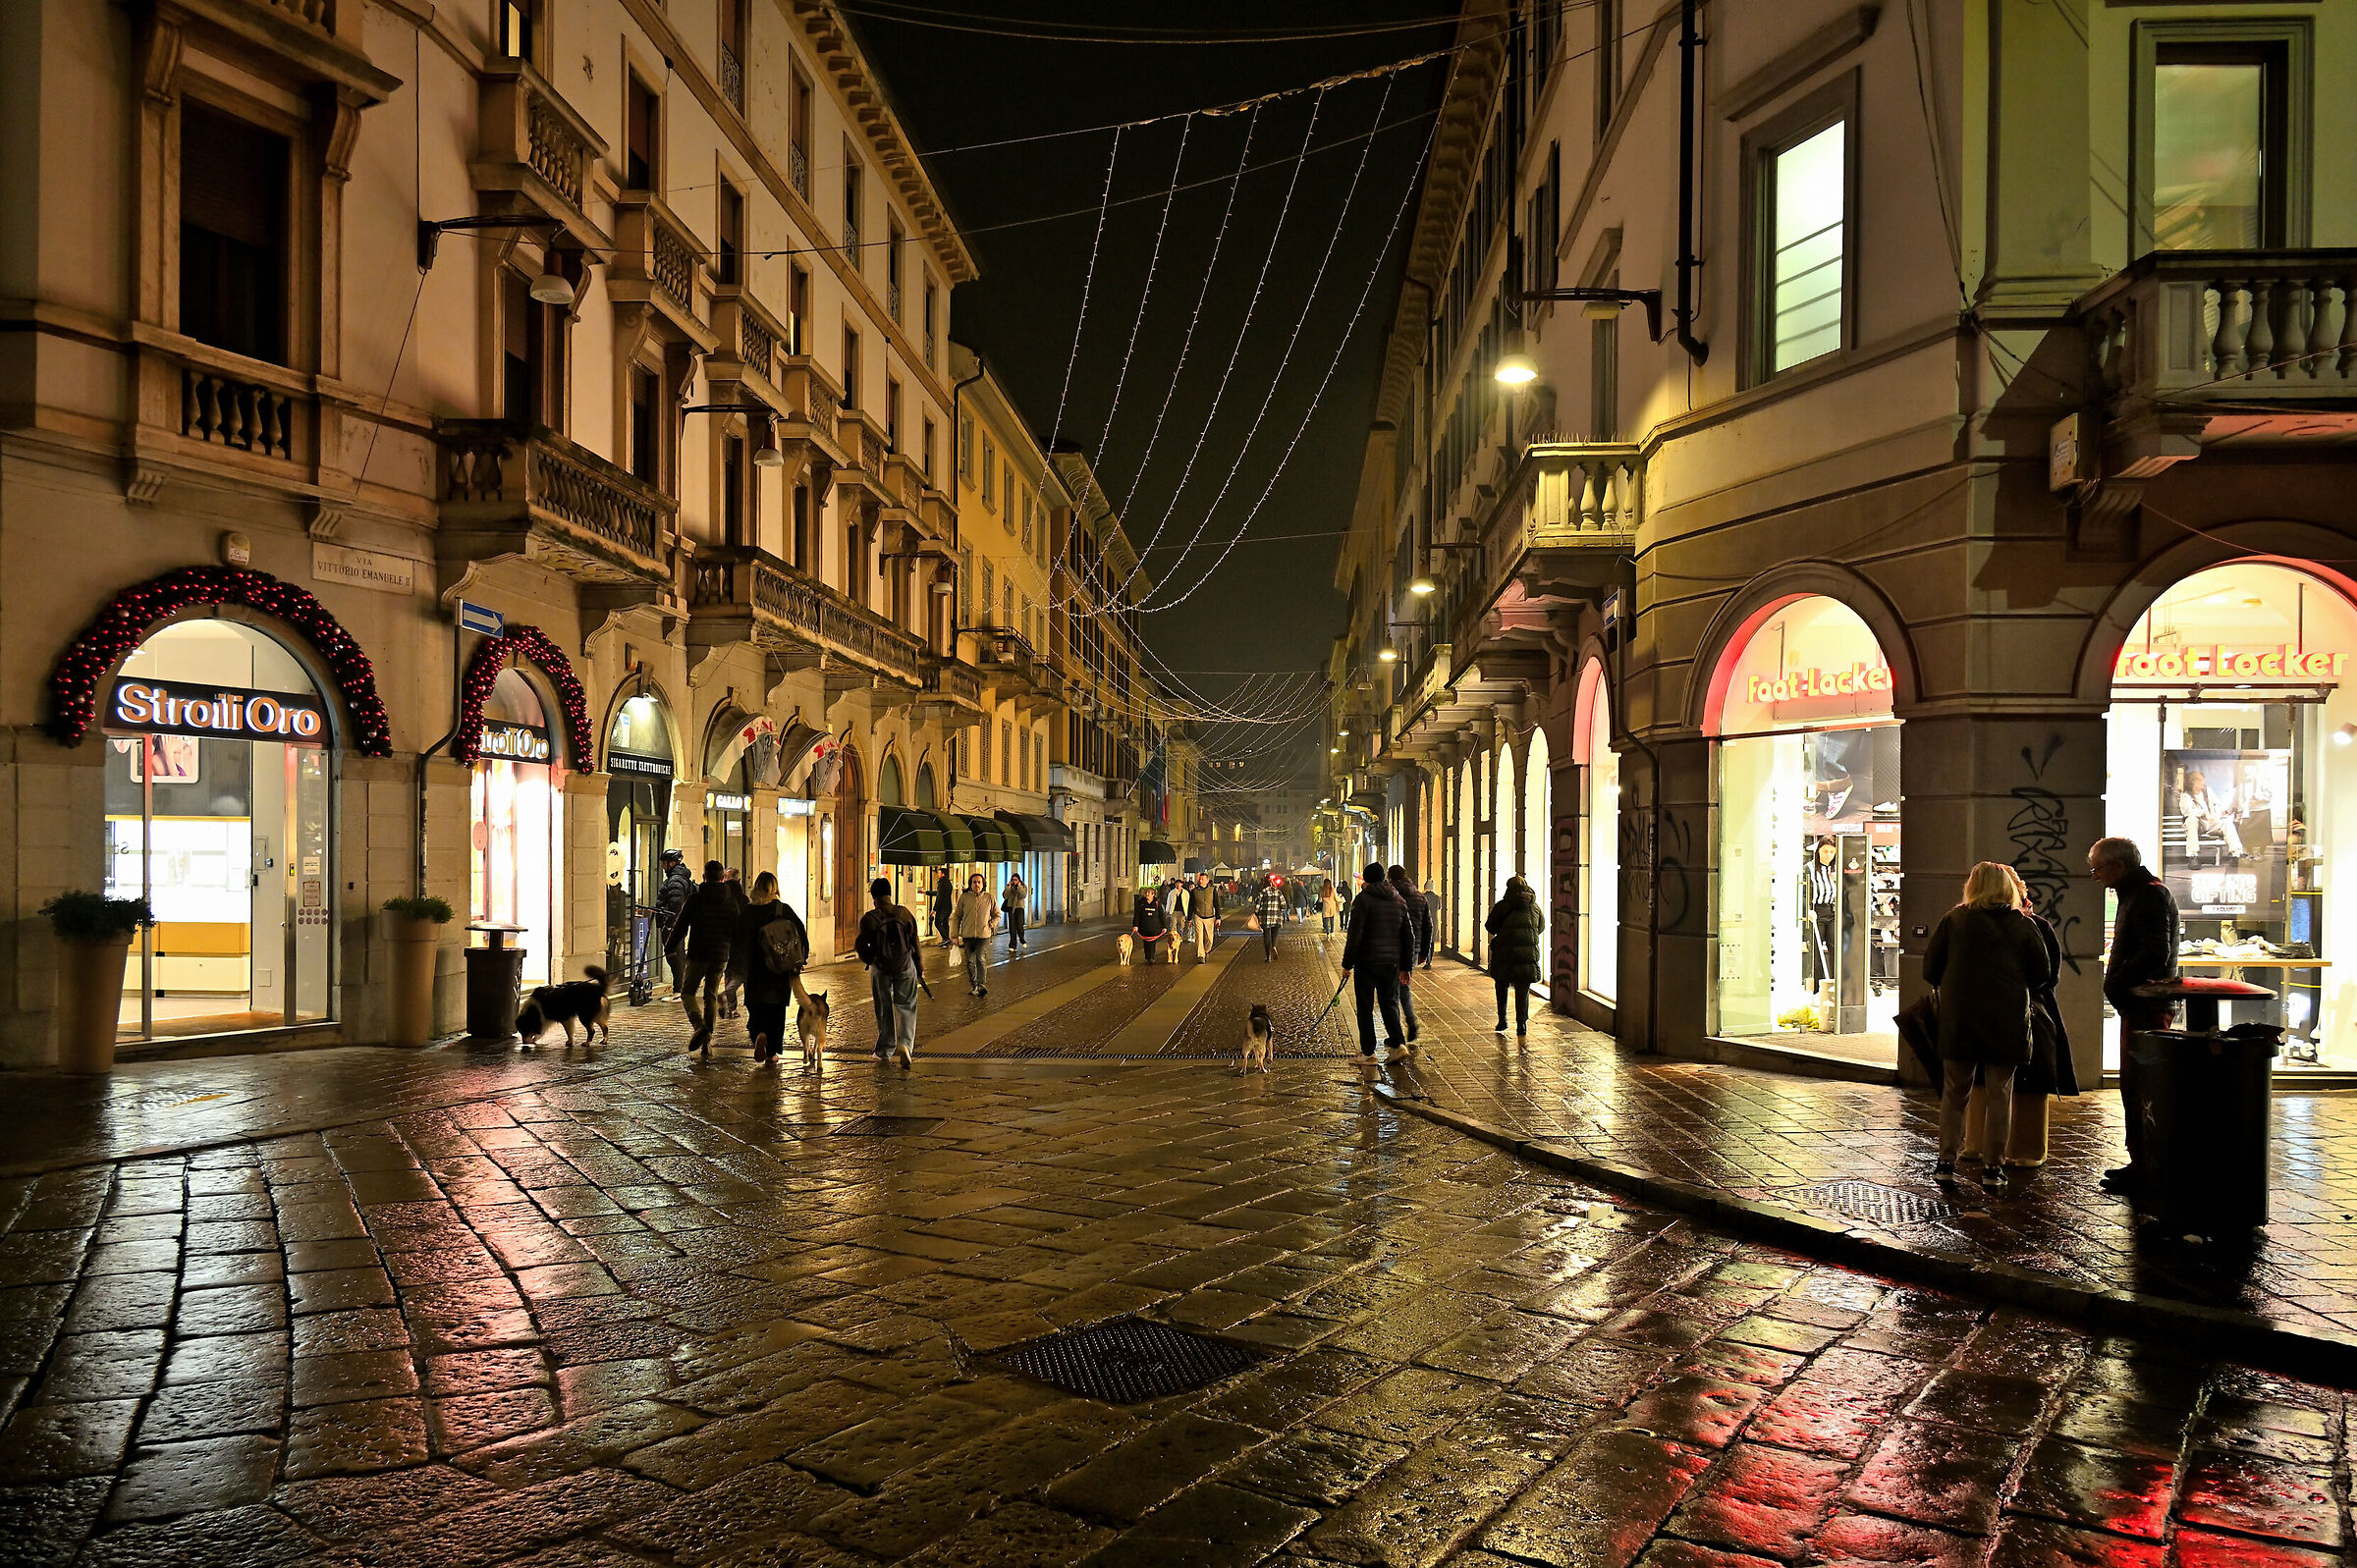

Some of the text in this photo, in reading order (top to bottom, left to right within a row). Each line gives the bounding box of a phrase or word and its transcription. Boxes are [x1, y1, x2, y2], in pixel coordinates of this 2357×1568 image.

[317, 561, 359, 577] VITTORIO
[362, 569, 404, 586] EMANUELE
[356, 557, 372, 567] VIA
[2115, 643, 2350, 677] Foot Locker
[1747, 672, 1800, 703] Foot
[117, 683, 322, 736] Stroili Oro
[480, 726, 550, 760] troili Oro
[610, 757, 637, 771] SIGARETTE
[715, 794, 743, 809] GALLO
[2191, 888, 2257, 903] GIFTING
